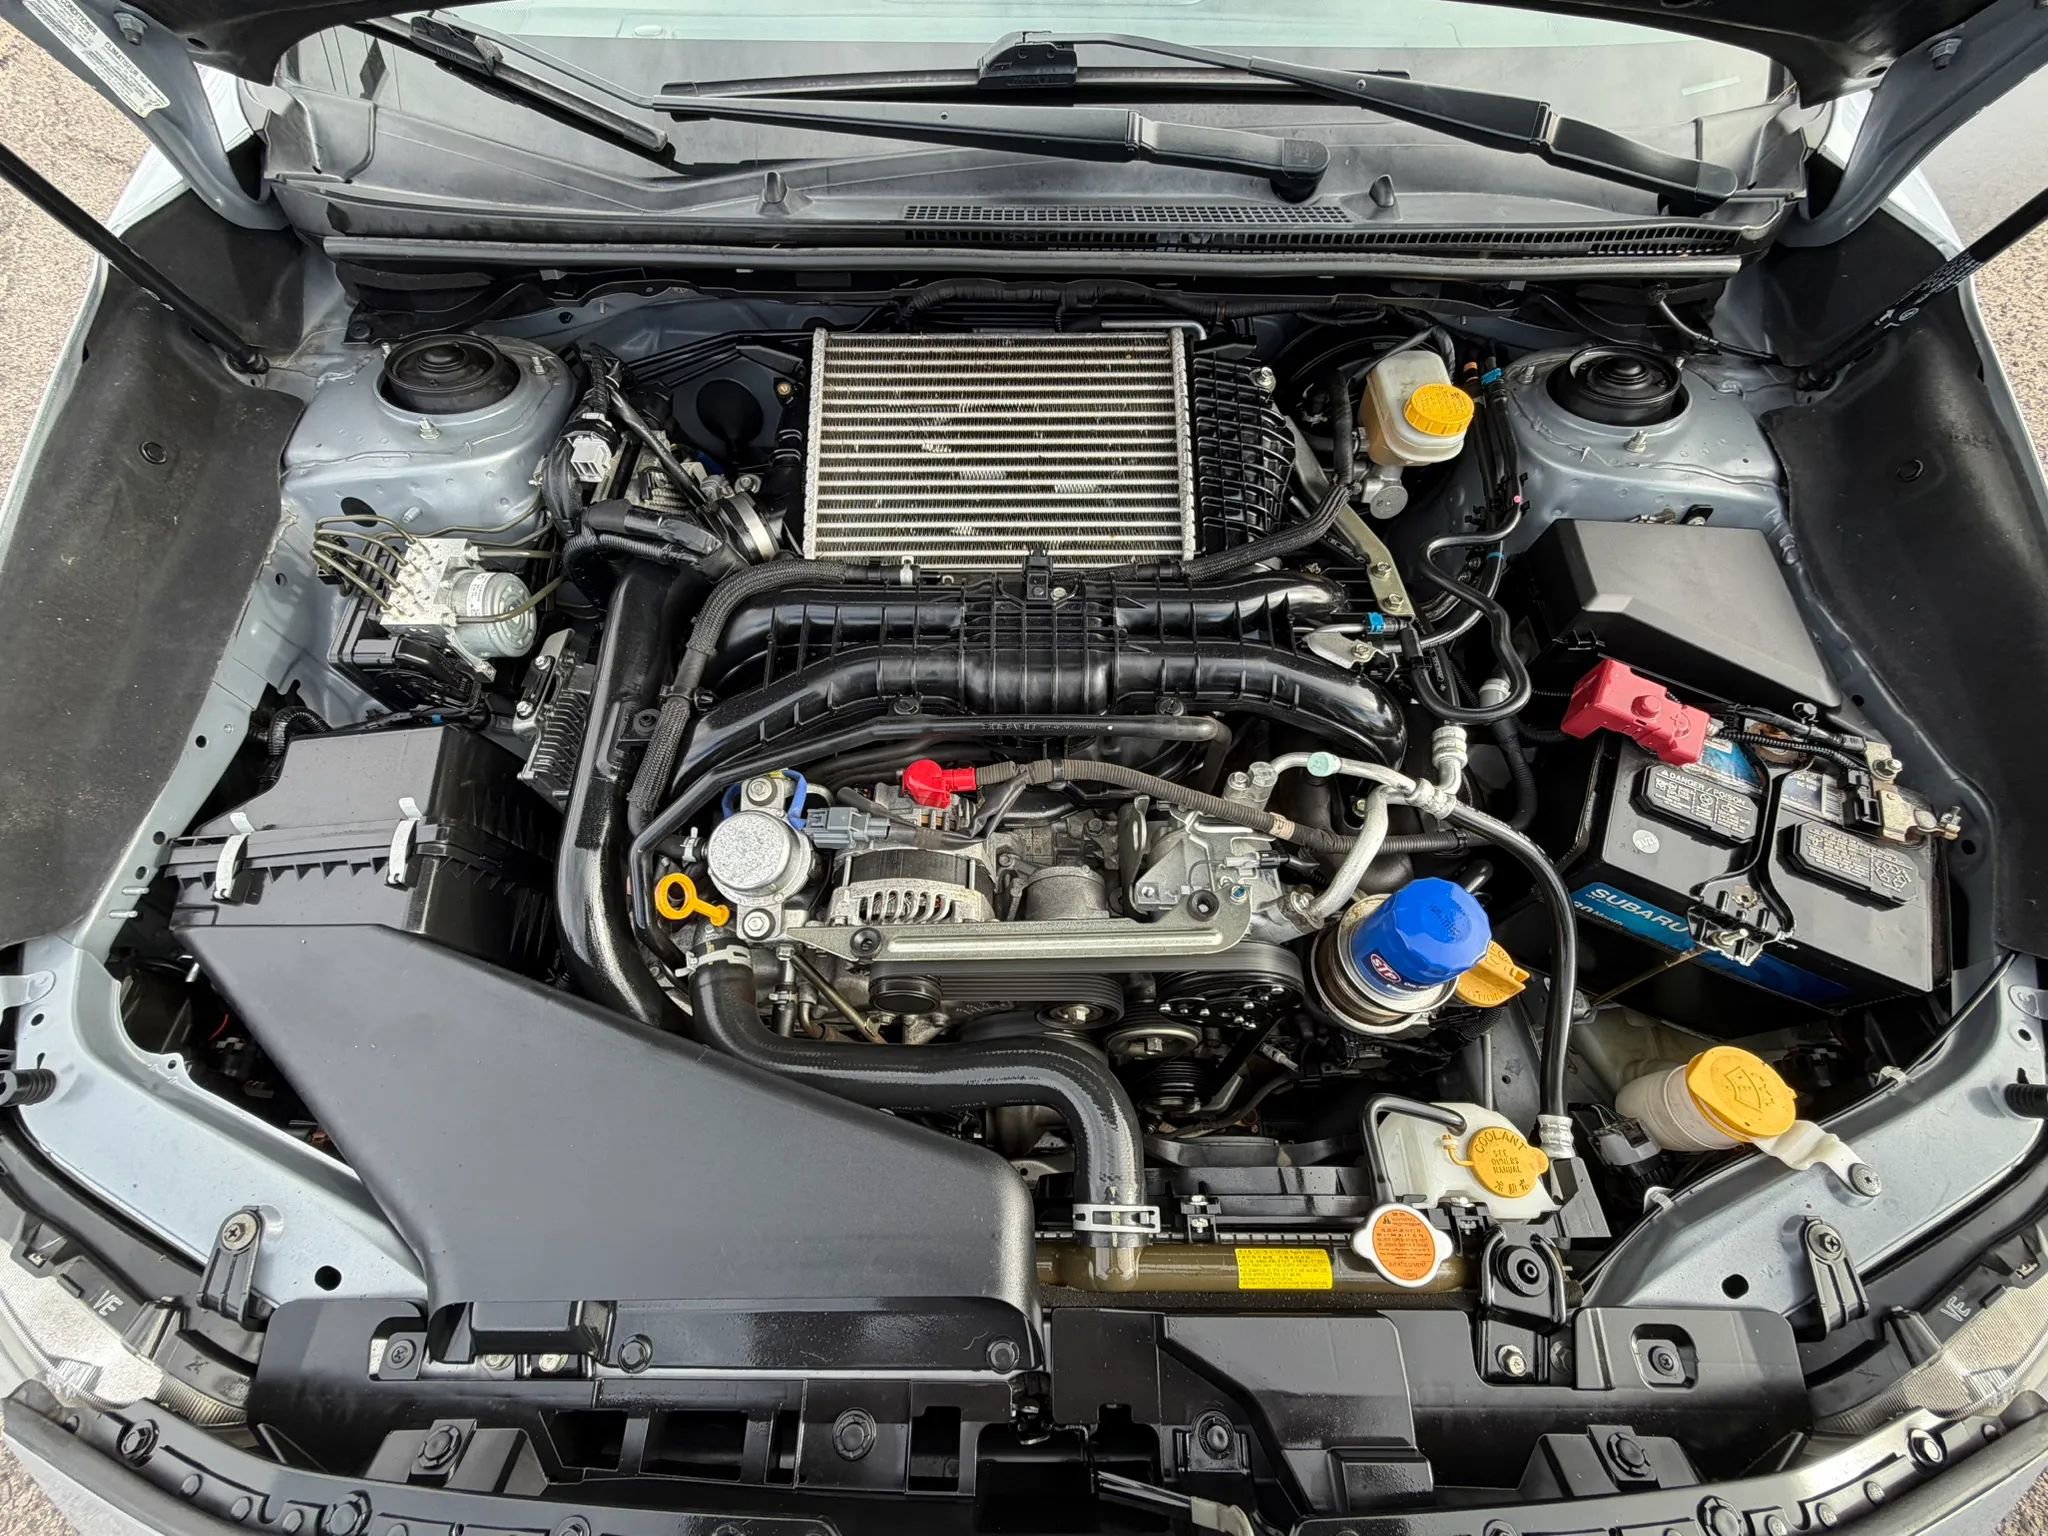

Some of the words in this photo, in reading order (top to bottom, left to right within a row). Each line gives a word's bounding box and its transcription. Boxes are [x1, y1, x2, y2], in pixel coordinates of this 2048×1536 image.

[1669, 772, 1705, 792] DANGER
[1713, 788, 1747, 806] POISON
[1590, 888, 1690, 933] SUBARU
[1372, 955, 1400, 982] STP
[1474, 1130, 1528, 1154] COOLANT
[1493, 1149, 1508, 1158] SEE
[1493, 1165, 1523, 1174] MANUAL
